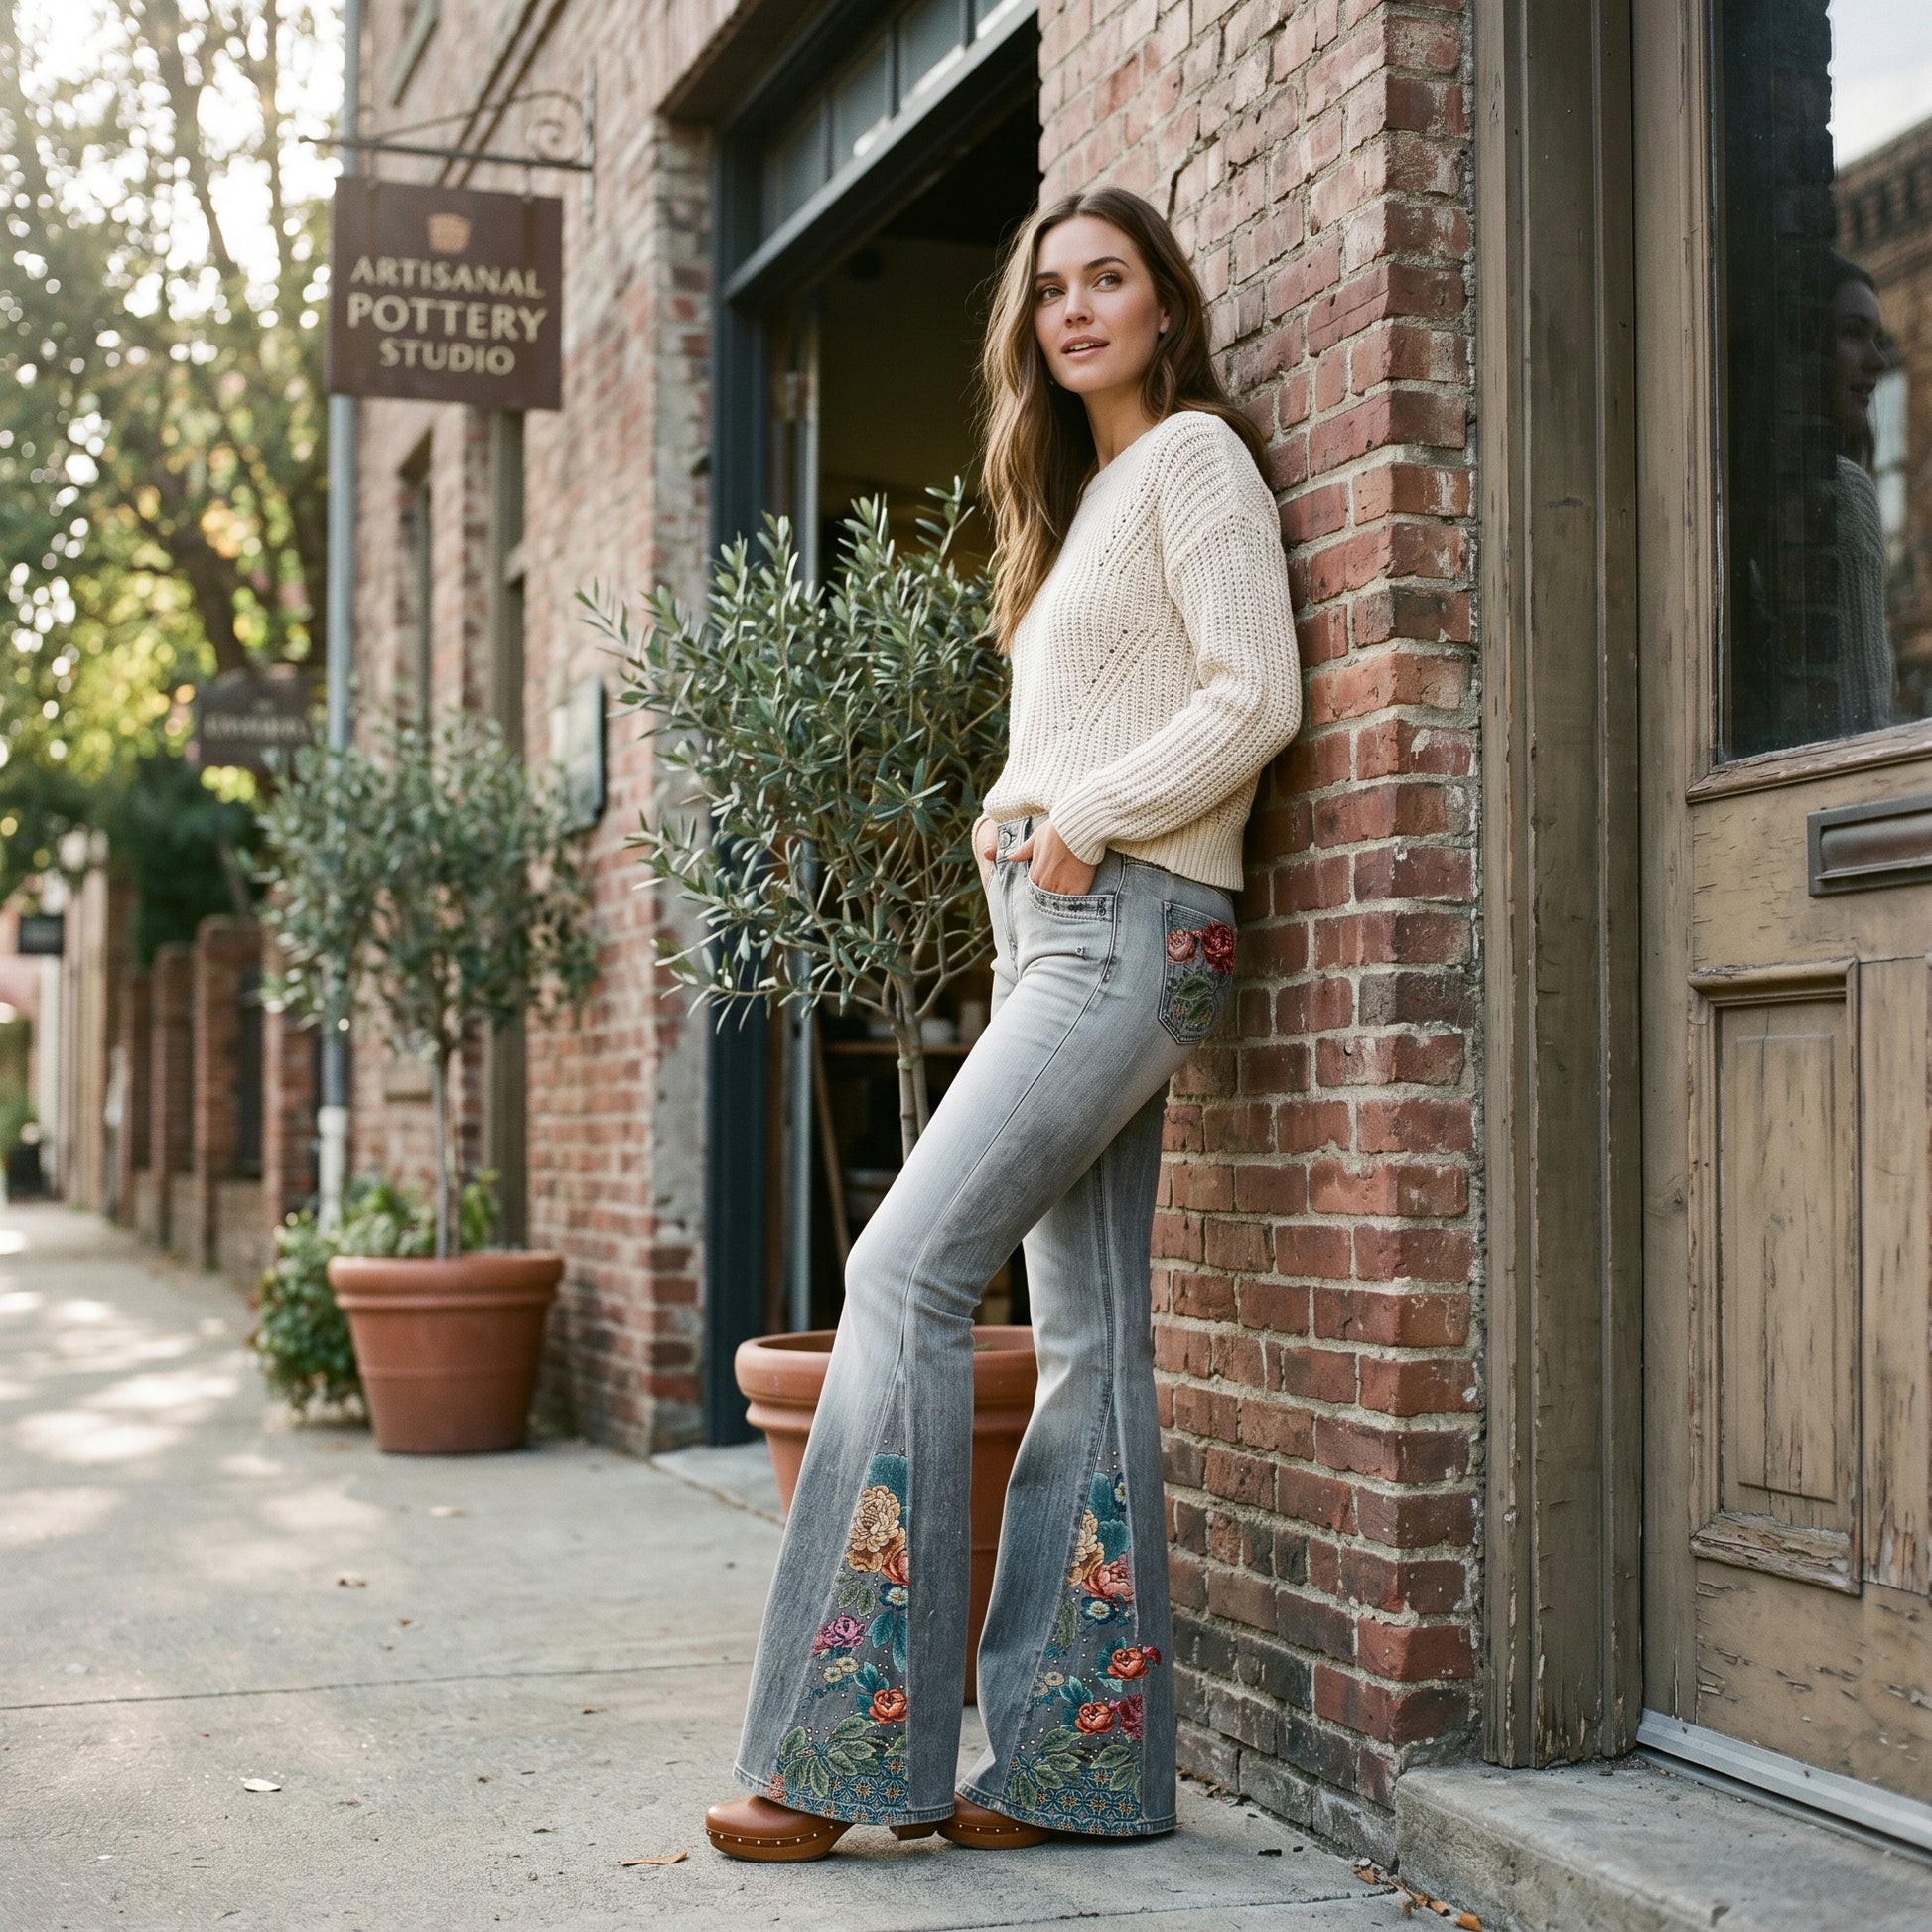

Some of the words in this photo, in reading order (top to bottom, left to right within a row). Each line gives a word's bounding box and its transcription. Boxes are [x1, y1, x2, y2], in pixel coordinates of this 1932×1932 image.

[349, 255, 545, 299] ARTISANAL
[347, 292, 548, 343] POTTERY
[379, 337, 516, 376] STUDIO
